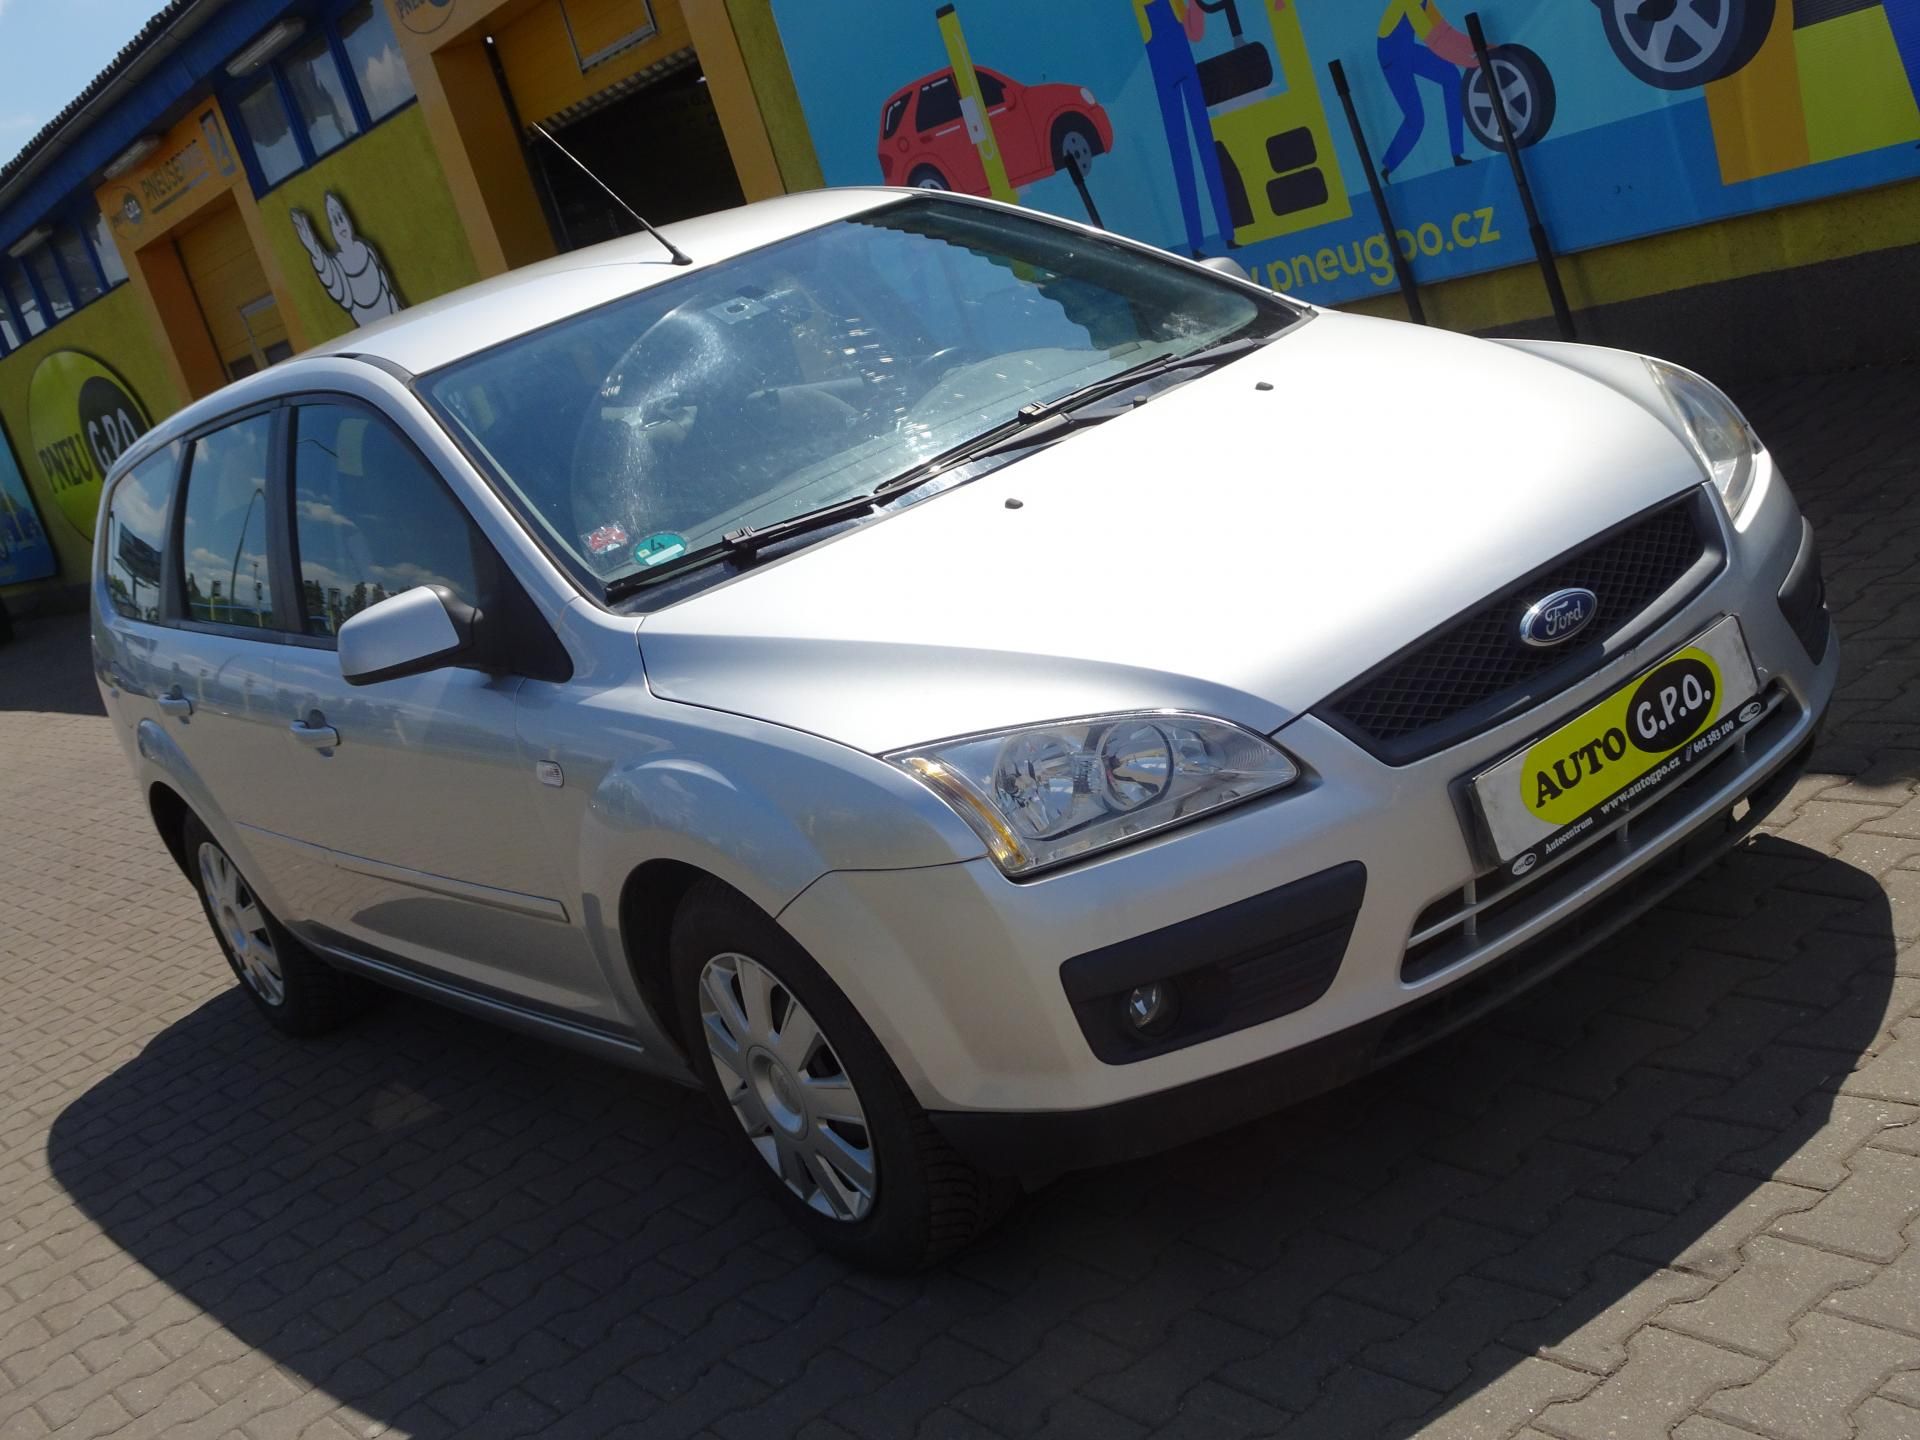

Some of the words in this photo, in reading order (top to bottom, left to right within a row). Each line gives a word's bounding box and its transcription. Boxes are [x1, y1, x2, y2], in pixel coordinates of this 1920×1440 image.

[1250, 207, 1500, 292] pneugo.cz
[38, 433, 94, 494] PNEU
[1544, 600, 1584, 636] Ford
[1536, 727, 1627, 808] AUTO
[1636, 673, 1711, 739] G.P.O.
[1545, 817, 1594, 855] Autocentrum
[1600, 757, 1681, 815] www.autogpo.cz
[1693, 737, 1707, 753] 602
[1721, 719, 1734, 735] 100
